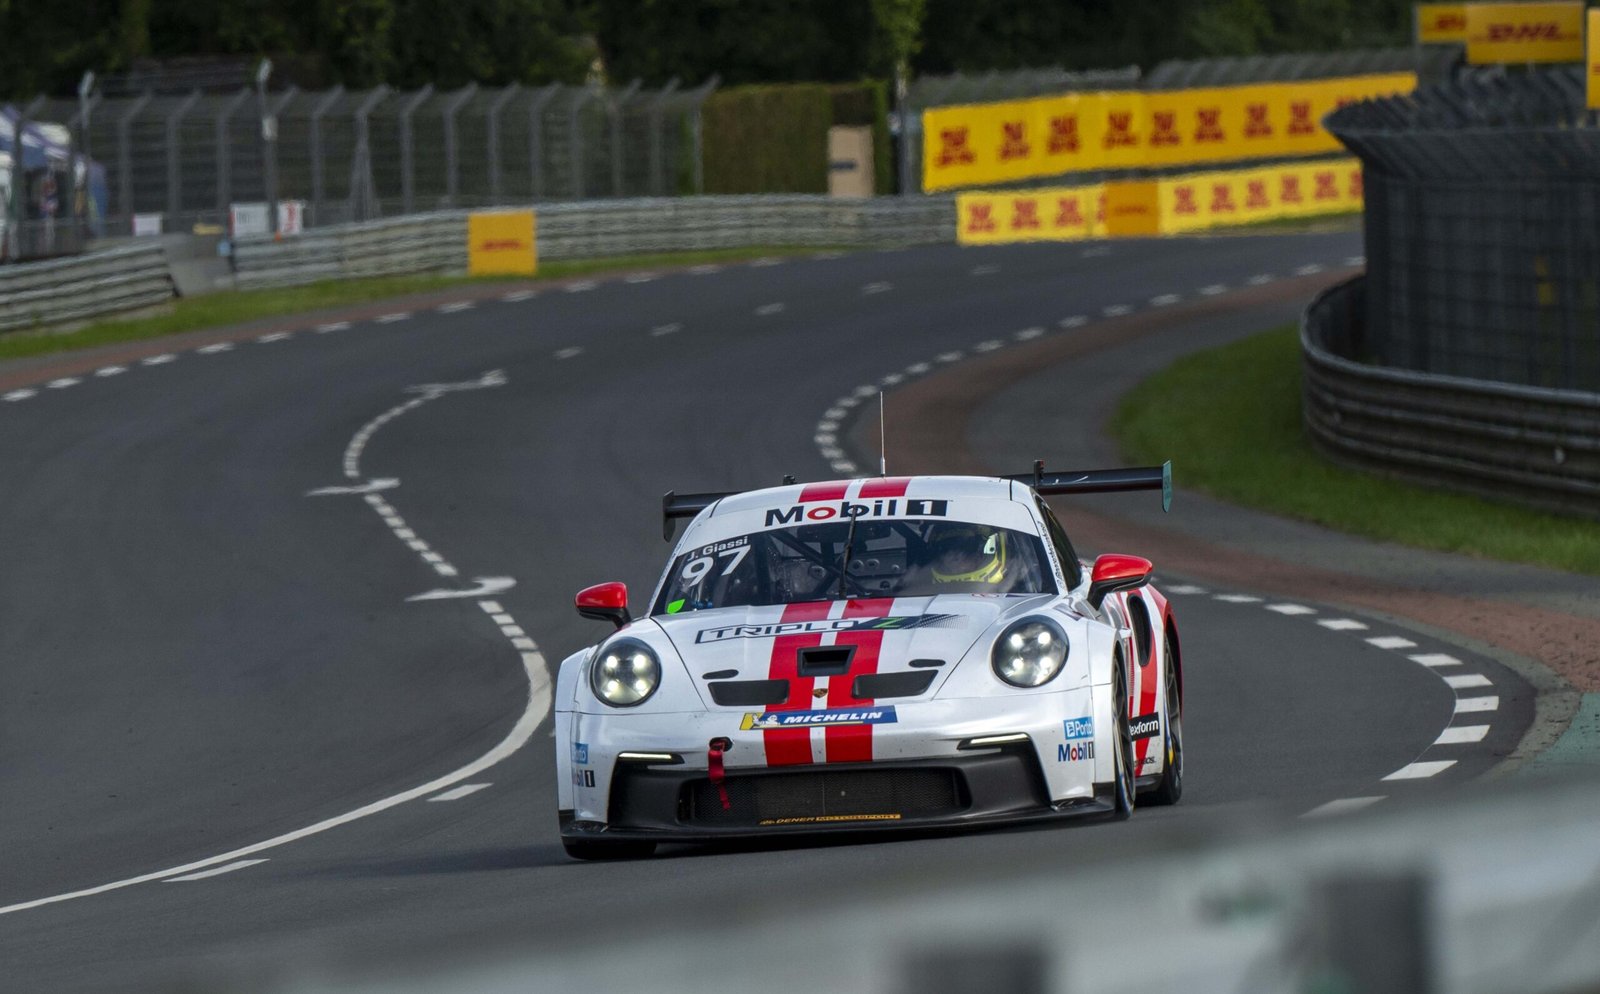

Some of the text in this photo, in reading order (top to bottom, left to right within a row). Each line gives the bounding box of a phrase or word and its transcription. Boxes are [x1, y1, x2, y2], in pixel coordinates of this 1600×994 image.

[764, 499, 898, 527] Mobil
[687, 535, 748, 562] J. Giassi
[682, 544, 751, 588] 97
[709, 617, 905, 638] TRIPLO Z
[783, 711, 883, 724] MICHELIN
[1128, 719, 1159, 736] lexform
[1074, 720, 1093, 737] Porto
[1058, 742, 1088, 762] Mobil
[776, 816, 815, 824] DENER
